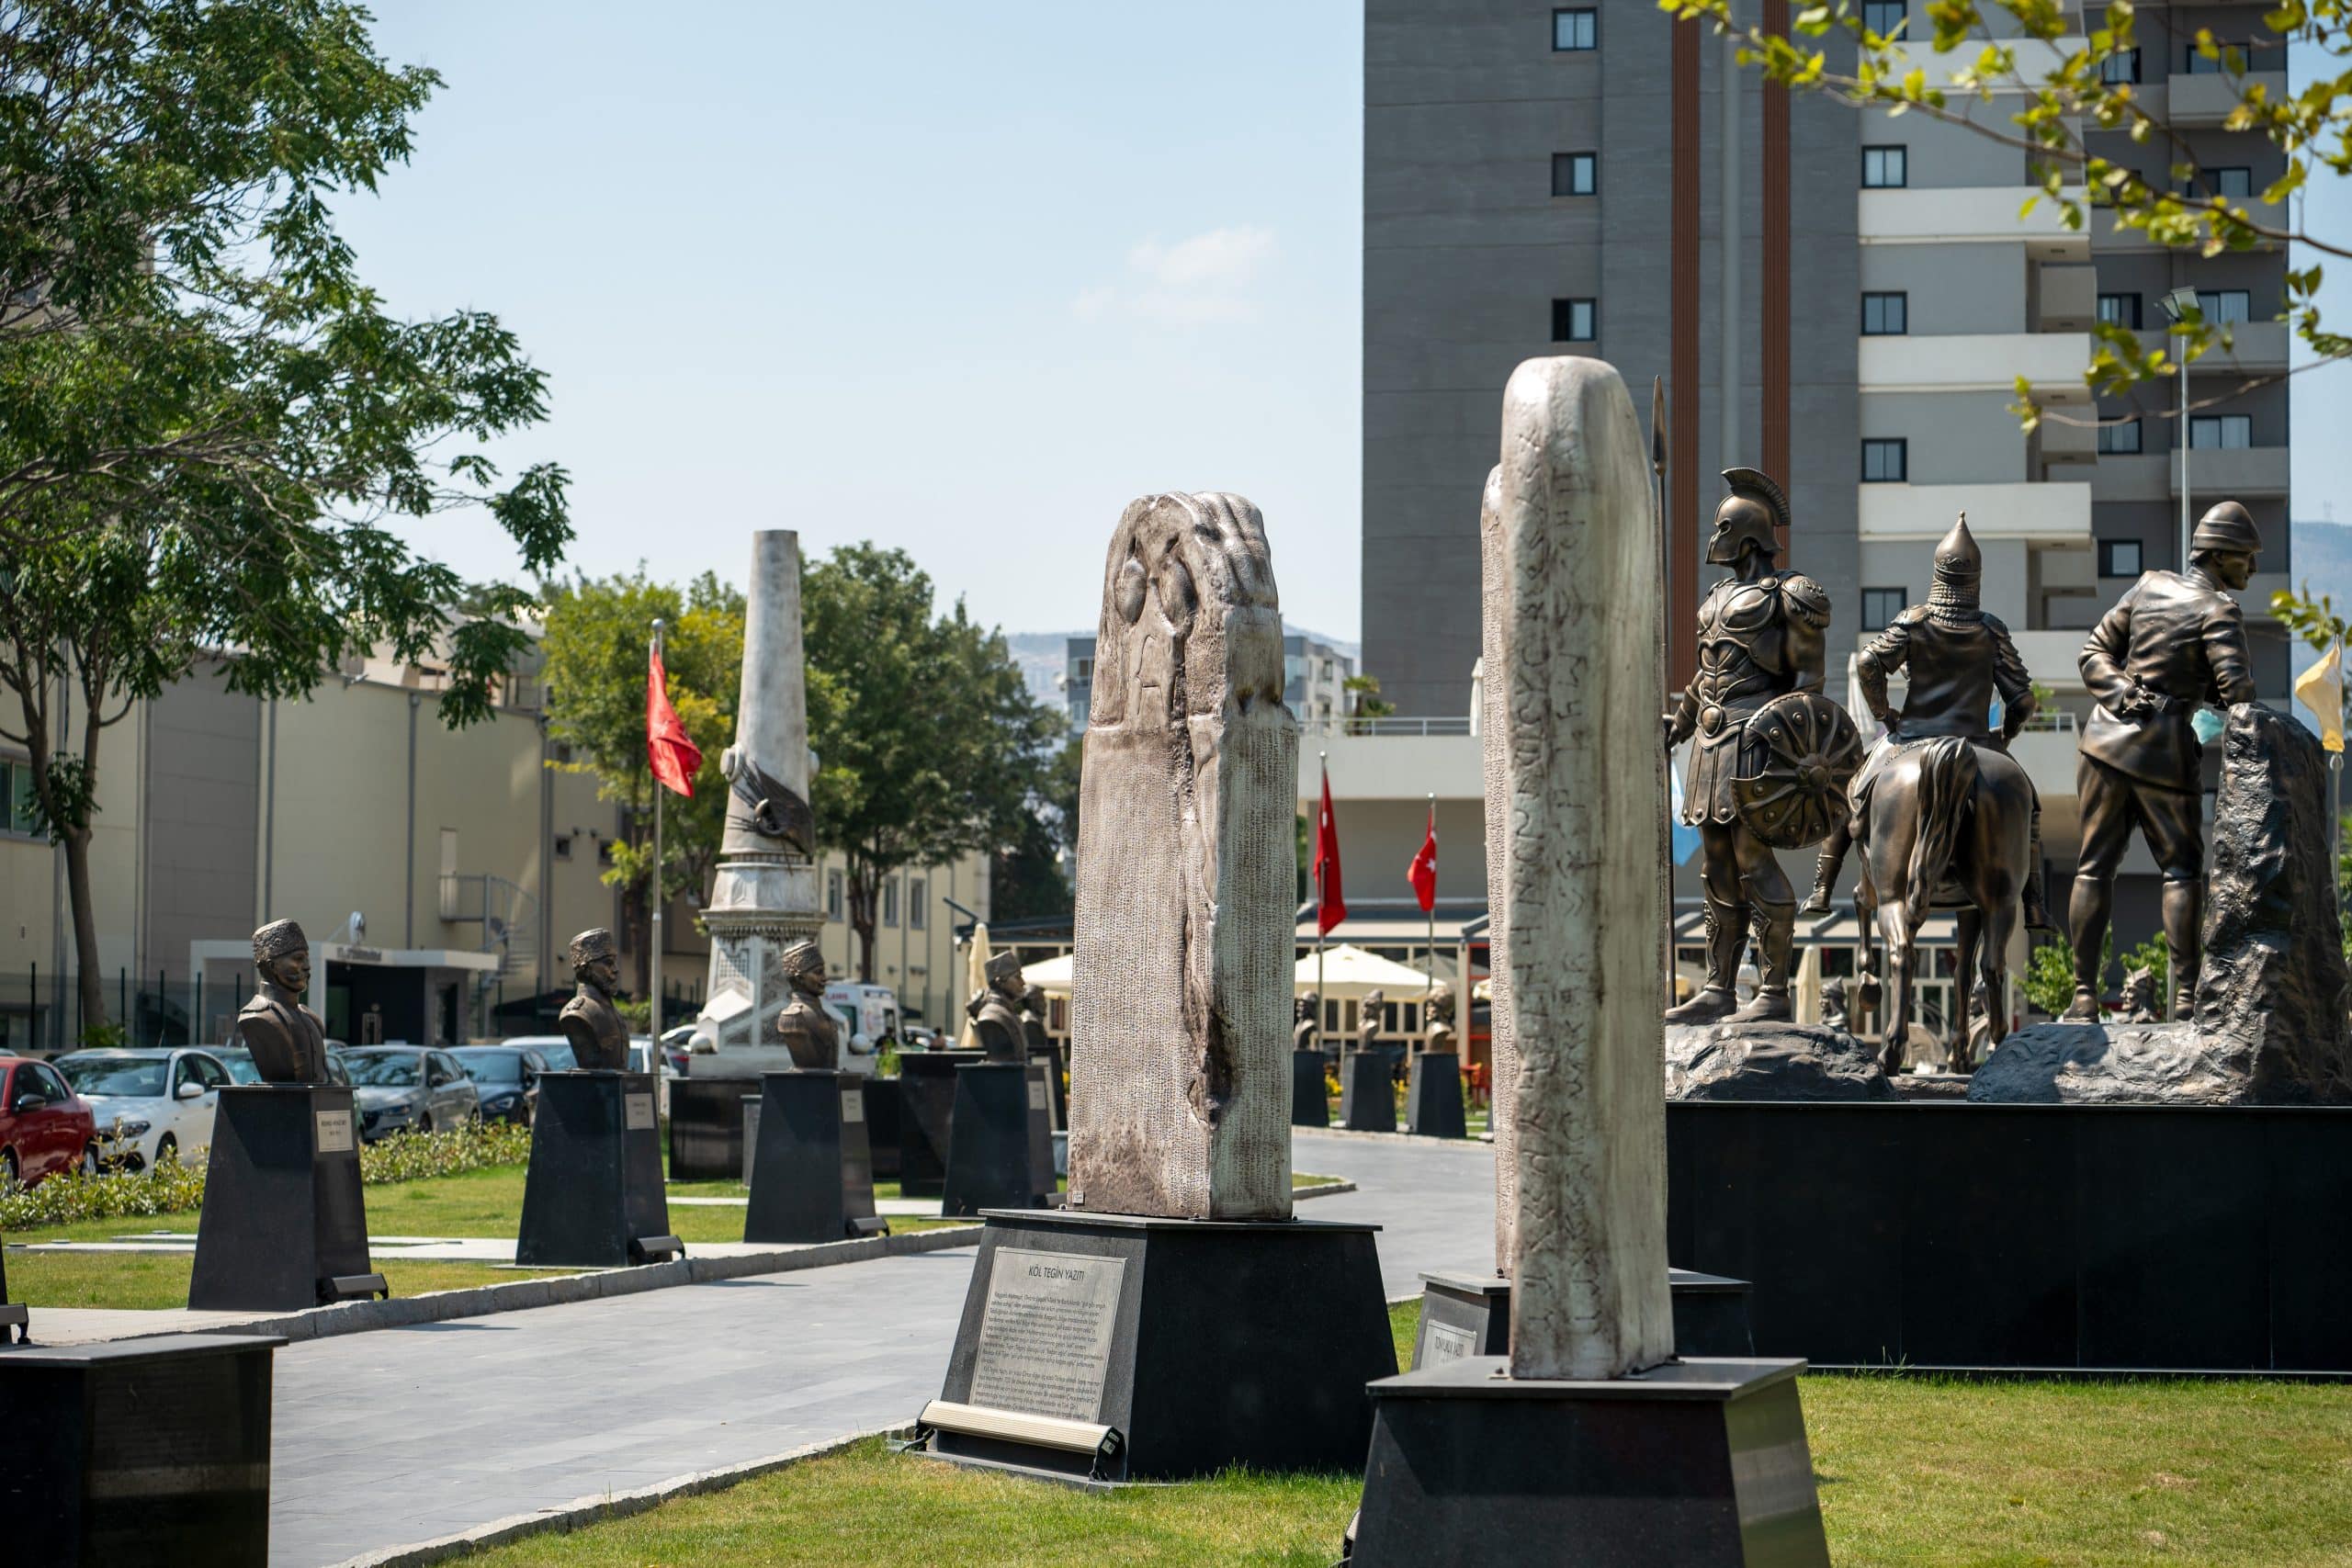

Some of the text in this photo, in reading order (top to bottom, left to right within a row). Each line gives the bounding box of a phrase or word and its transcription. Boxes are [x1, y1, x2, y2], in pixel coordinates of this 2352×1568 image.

[1028, 1264, 1085, 1281] KÖL TEGİN YAZITI
